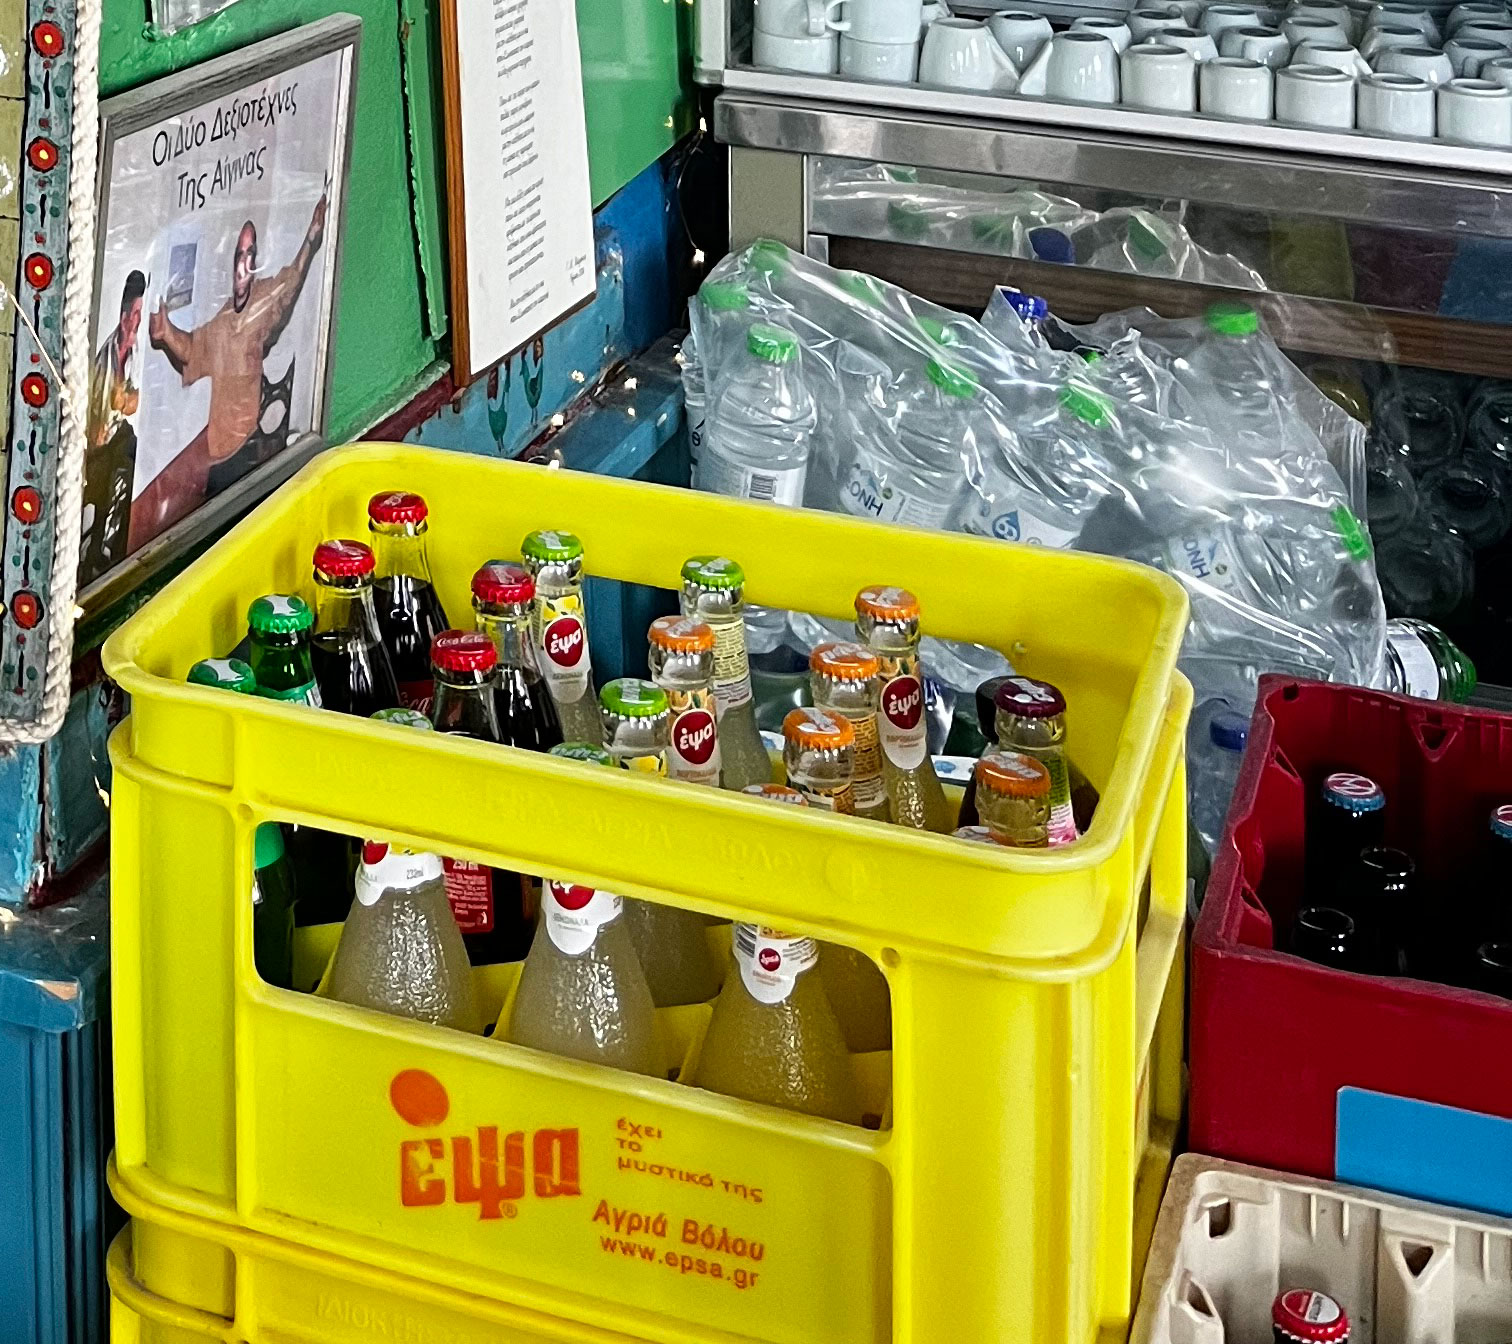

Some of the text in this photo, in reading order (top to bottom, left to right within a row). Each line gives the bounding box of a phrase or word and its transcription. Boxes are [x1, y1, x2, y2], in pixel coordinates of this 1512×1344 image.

[152, 82, 299, 167] Οι Δύο Δεξιοτέχνες
[177, 170, 208, 211] Της
[616, 1116, 664, 1140] έχει
[616, 1137, 643, 1154] το
[617, 1155, 764, 1204] μυστικό της
[592, 1199, 766, 1262] Αγριά Βόλου
[598, 1232, 761, 1291] www.epsa.gr
